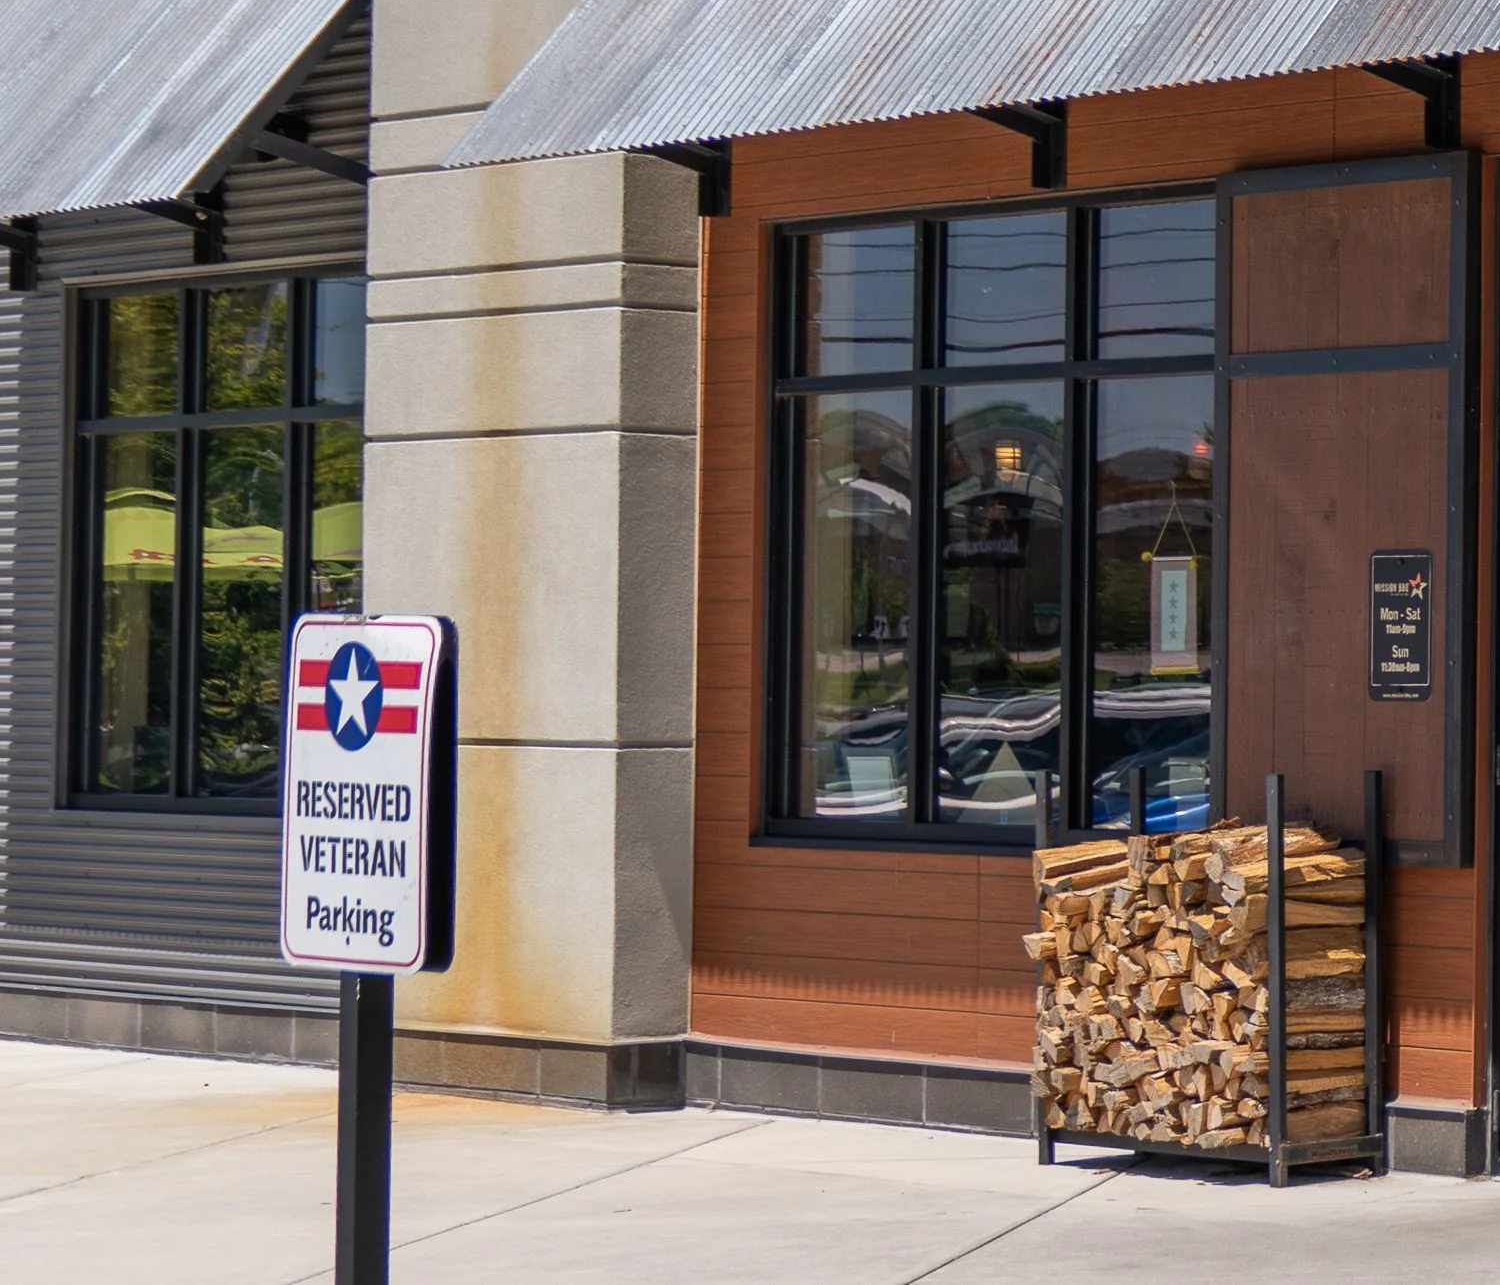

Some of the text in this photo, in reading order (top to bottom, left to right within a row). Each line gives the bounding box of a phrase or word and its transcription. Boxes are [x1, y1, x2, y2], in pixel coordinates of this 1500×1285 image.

[1380, 607, 1399, 621] Mon
[1406, 607, 1421, 620] Sat
[1392, 645, 1409, 658] Sun
[296, 779, 412, 822] RESERVED
[300, 834, 406, 878] VETERAN
[306, 895, 396, 947] Parking
